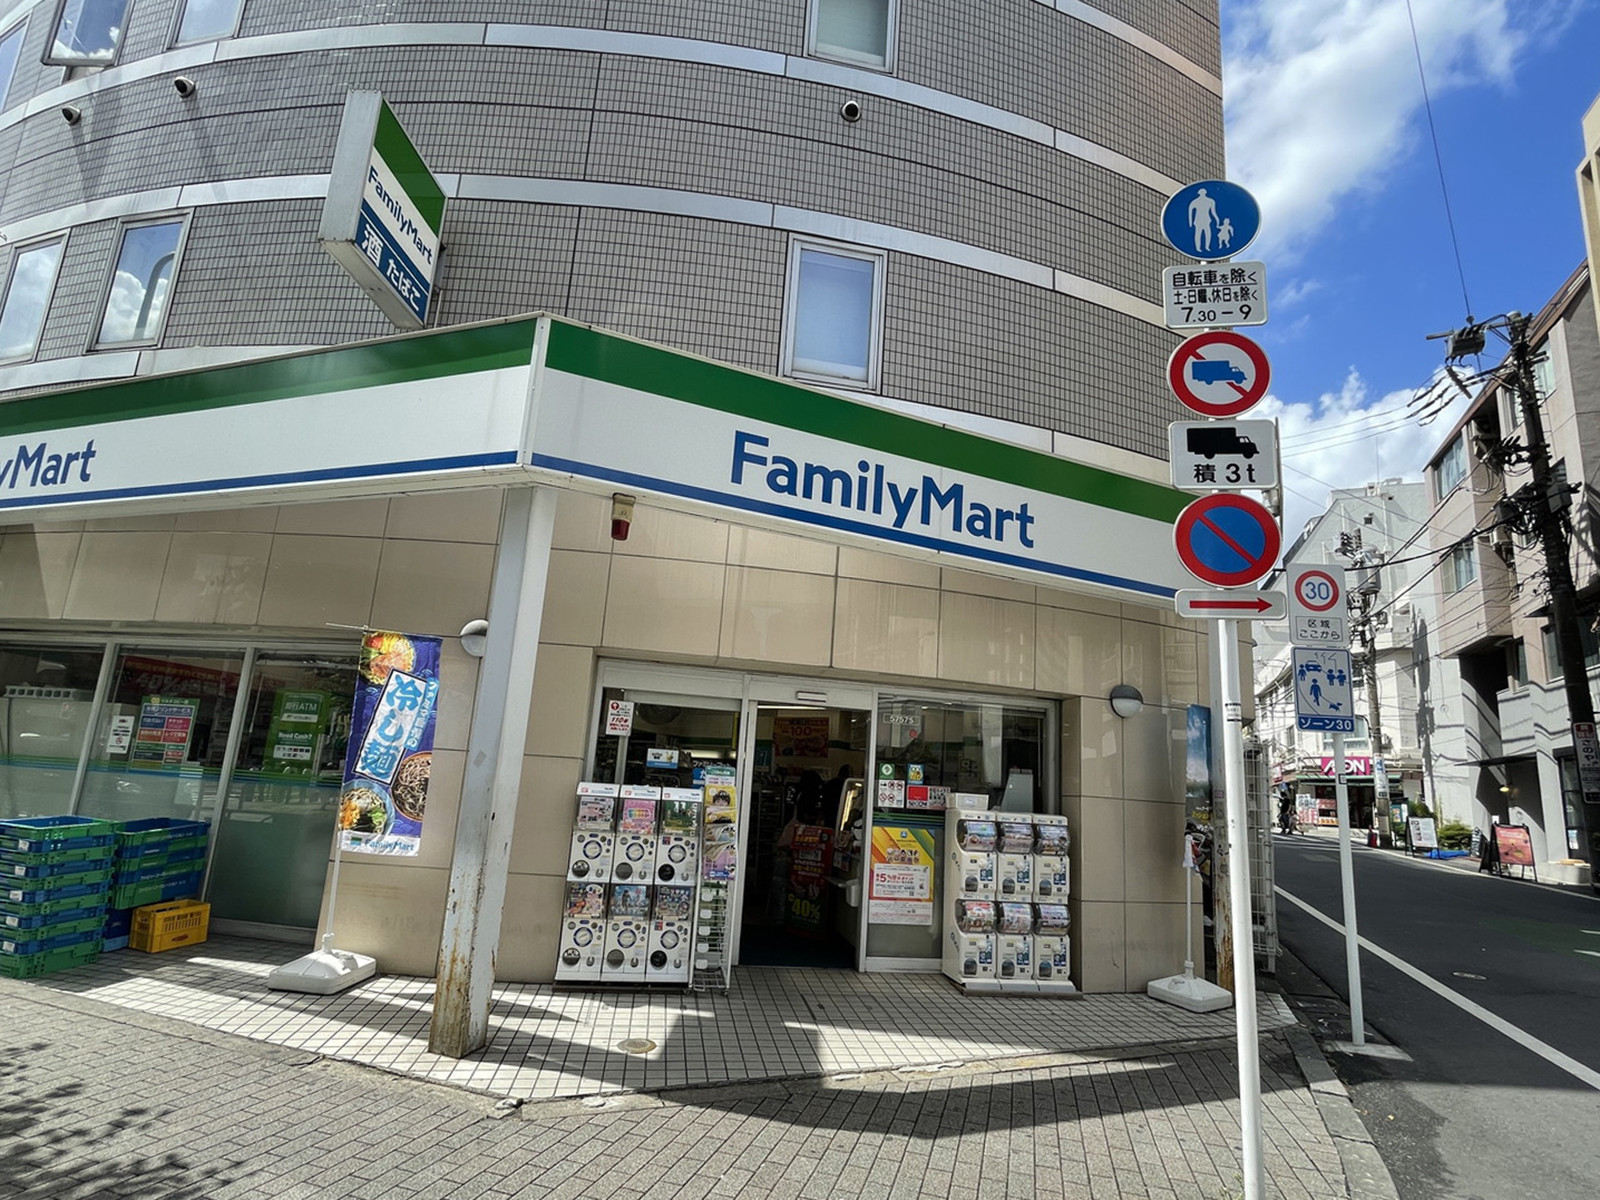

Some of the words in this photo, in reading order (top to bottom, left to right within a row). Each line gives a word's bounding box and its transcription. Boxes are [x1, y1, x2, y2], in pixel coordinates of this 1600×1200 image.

[368, 165, 434, 265] FamilyMart
[362, 223, 383, 267] 酒
[386, 258, 421, 312] たばこ
[1173, 267, 1257, 287] 自転車を除く
[731, 430, 1035, 548] FamilyMart
[1305, 581, 1330, 600] 30
[1308, 619, 1331, 629] 区域
[1299, 630, 1341, 640] ここから
[360, 674, 423, 779] 冷し麺
[889, 714, 914, 724] 57575
[1300, 718, 1352, 731] ゾーン30
[1323, 759, 1366, 773] AON
